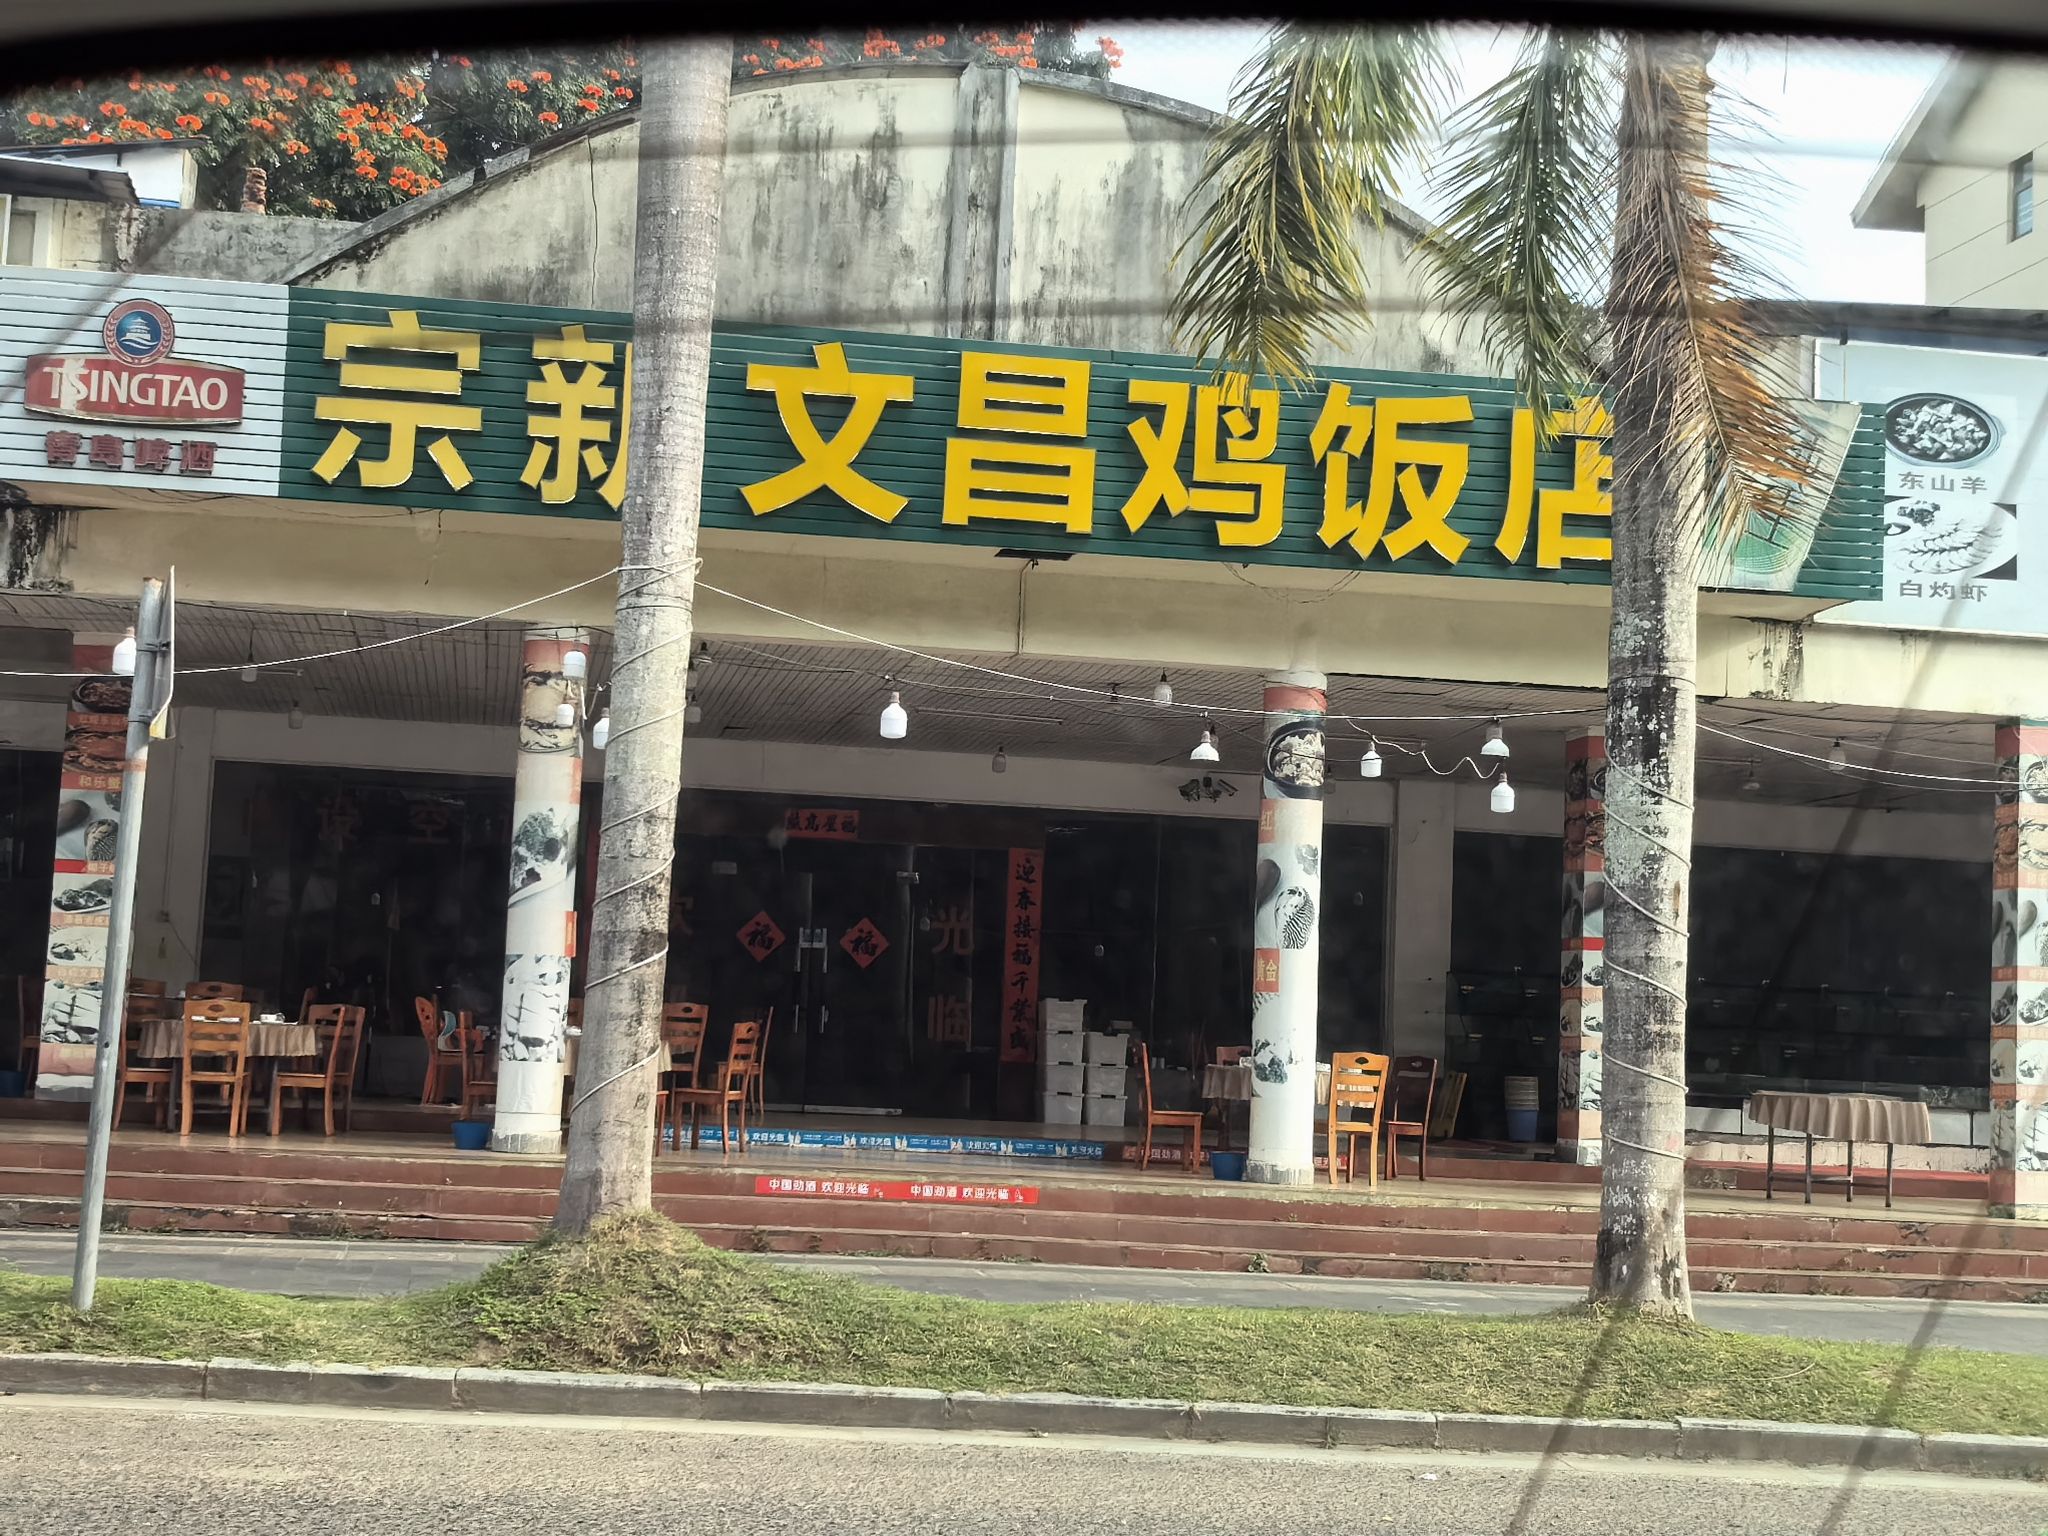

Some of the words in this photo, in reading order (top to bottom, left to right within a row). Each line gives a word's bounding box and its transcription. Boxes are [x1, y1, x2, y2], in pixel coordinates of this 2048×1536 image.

[43, 367, 228, 411] TSINGTAO
[1898, 471, 1988, 495] 东山羊
[1899, 579, 1989, 602] 白灼虾
[821, 1181, 870, 1195] 欢迎光临
